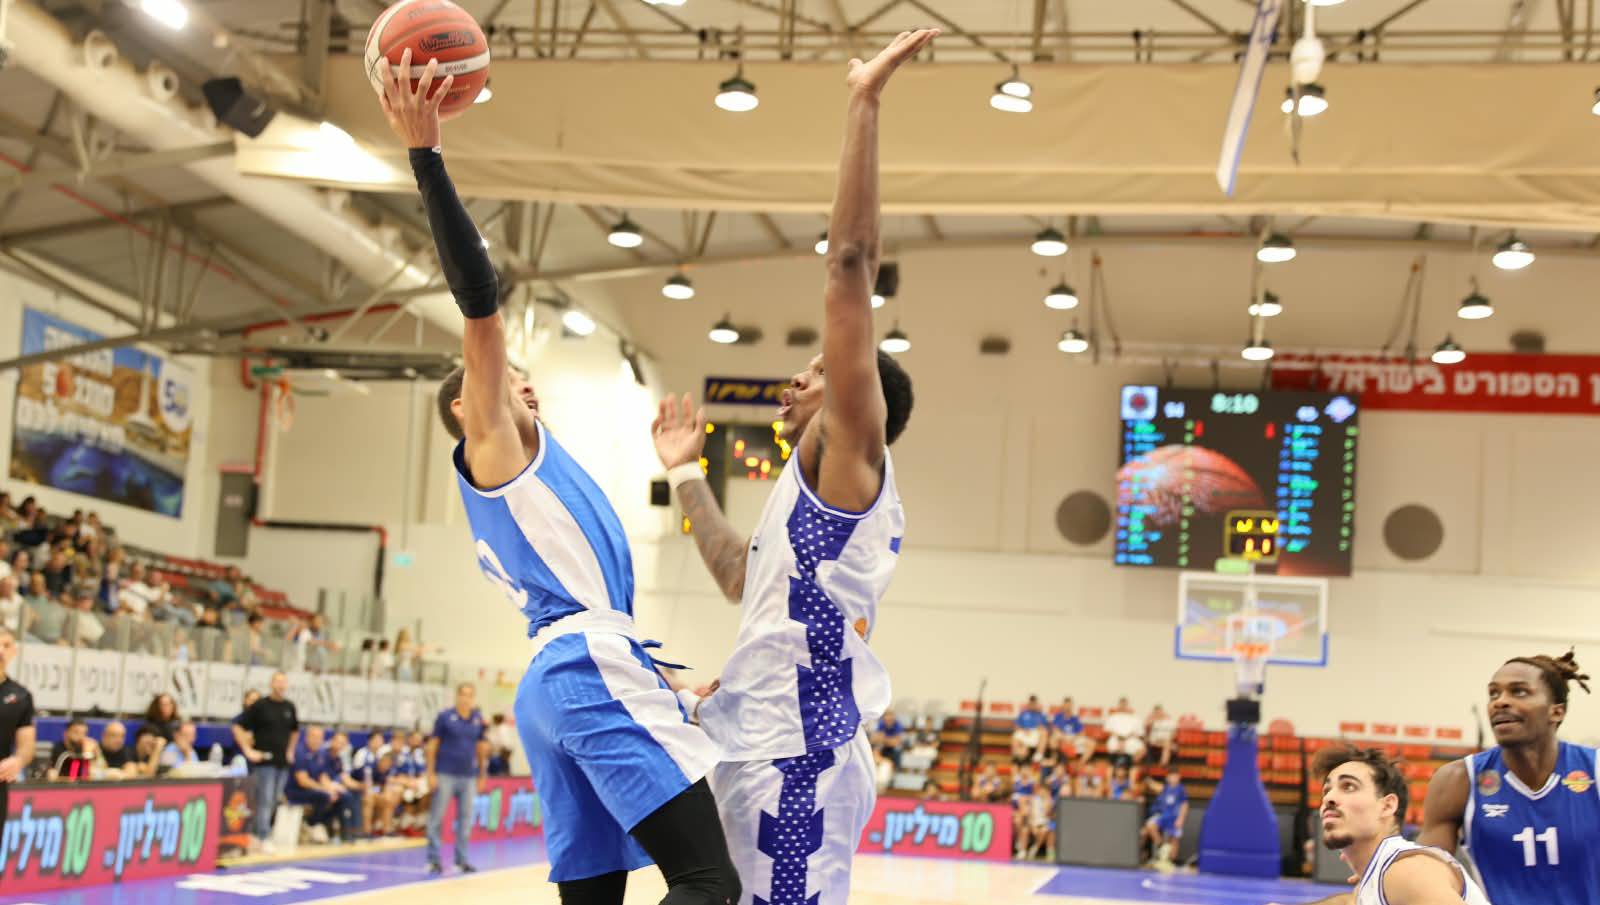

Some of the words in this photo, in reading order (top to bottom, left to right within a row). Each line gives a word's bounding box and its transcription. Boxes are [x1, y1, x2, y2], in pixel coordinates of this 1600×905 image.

[1455, 371, 1580, 398] הספורט
[0, 804, 63, 874] מיליו
[62, 803, 94, 875] 10
[179, 797, 207, 862] 10
[961, 812, 993, 853] 10
[1512, 826, 1560, 867] 11
